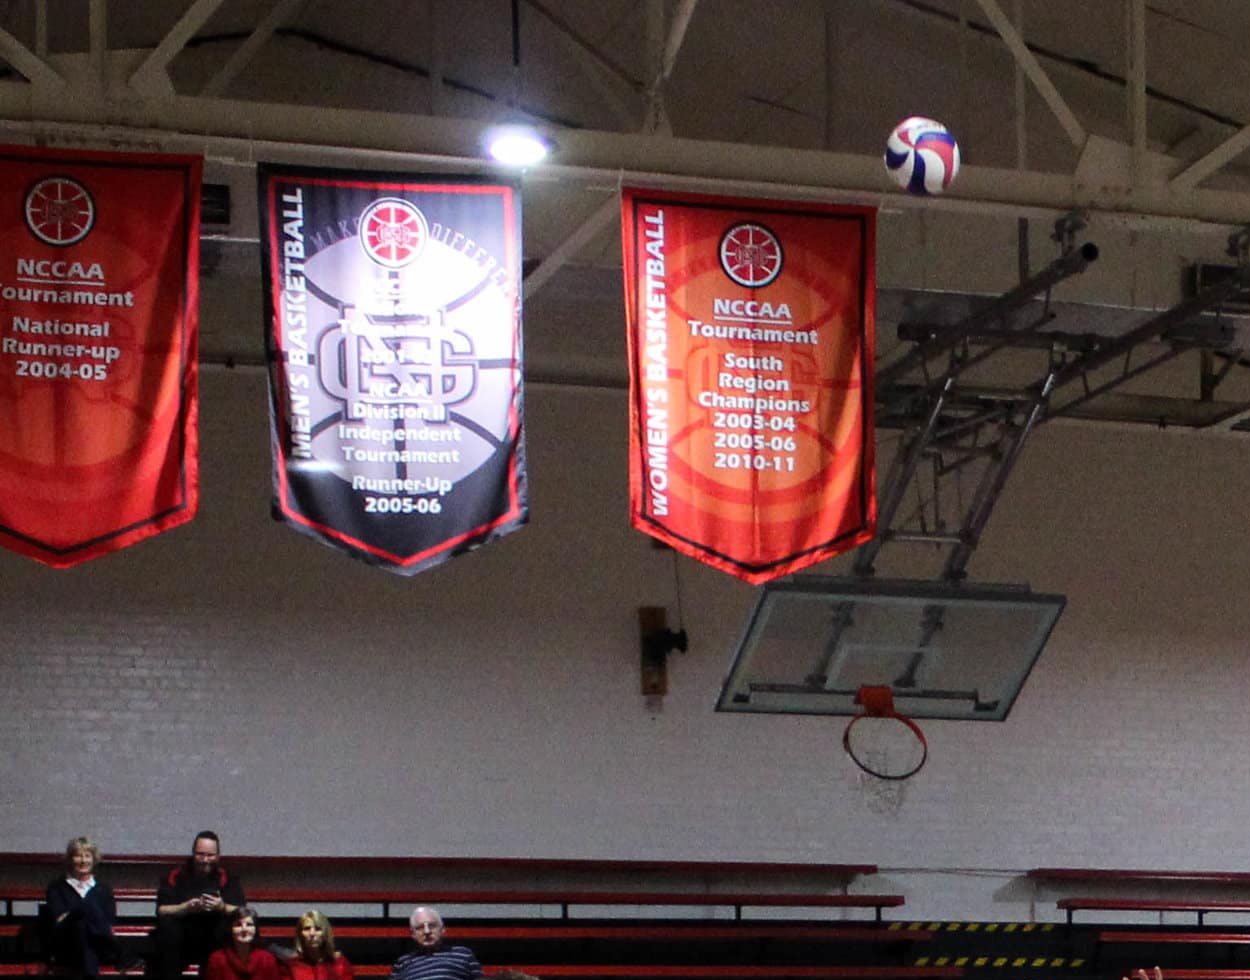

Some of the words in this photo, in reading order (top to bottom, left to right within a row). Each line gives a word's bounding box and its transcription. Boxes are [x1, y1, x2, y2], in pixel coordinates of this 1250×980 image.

[16, 259, 105, 280] NCCAA
[282, 187, 310, 367] BASKETBALL
[0, 283, 134, 307] ournament
[644, 208, 668, 382] BASKETBALL
[713, 298, 793, 319] NCCAA
[12, 316, 111, 337] National
[688, 320, 819, 345] Tournament
[2, 337, 121, 364] Runner-up
[15, 360, 108, 381] 2004-05
[724, 352, 785, 372] South
[718, 372, 790, 393] Region
[352, 403, 428, 420] Division
[698, 391, 811, 413] Champions
[289, 371, 313, 459] MEN'S
[713, 412, 797, 432] 2003-04
[339, 425, 462, 446] Independent
[713, 432, 797, 451] 2005-06
[342, 446, 461, 464] Tournament
[646, 387, 669, 518] WOMEN'S
[713, 452, 796, 472] 2010-11
[352, 475, 453, 496] Runner-Up
[364, 497, 443, 514] 2005-06
